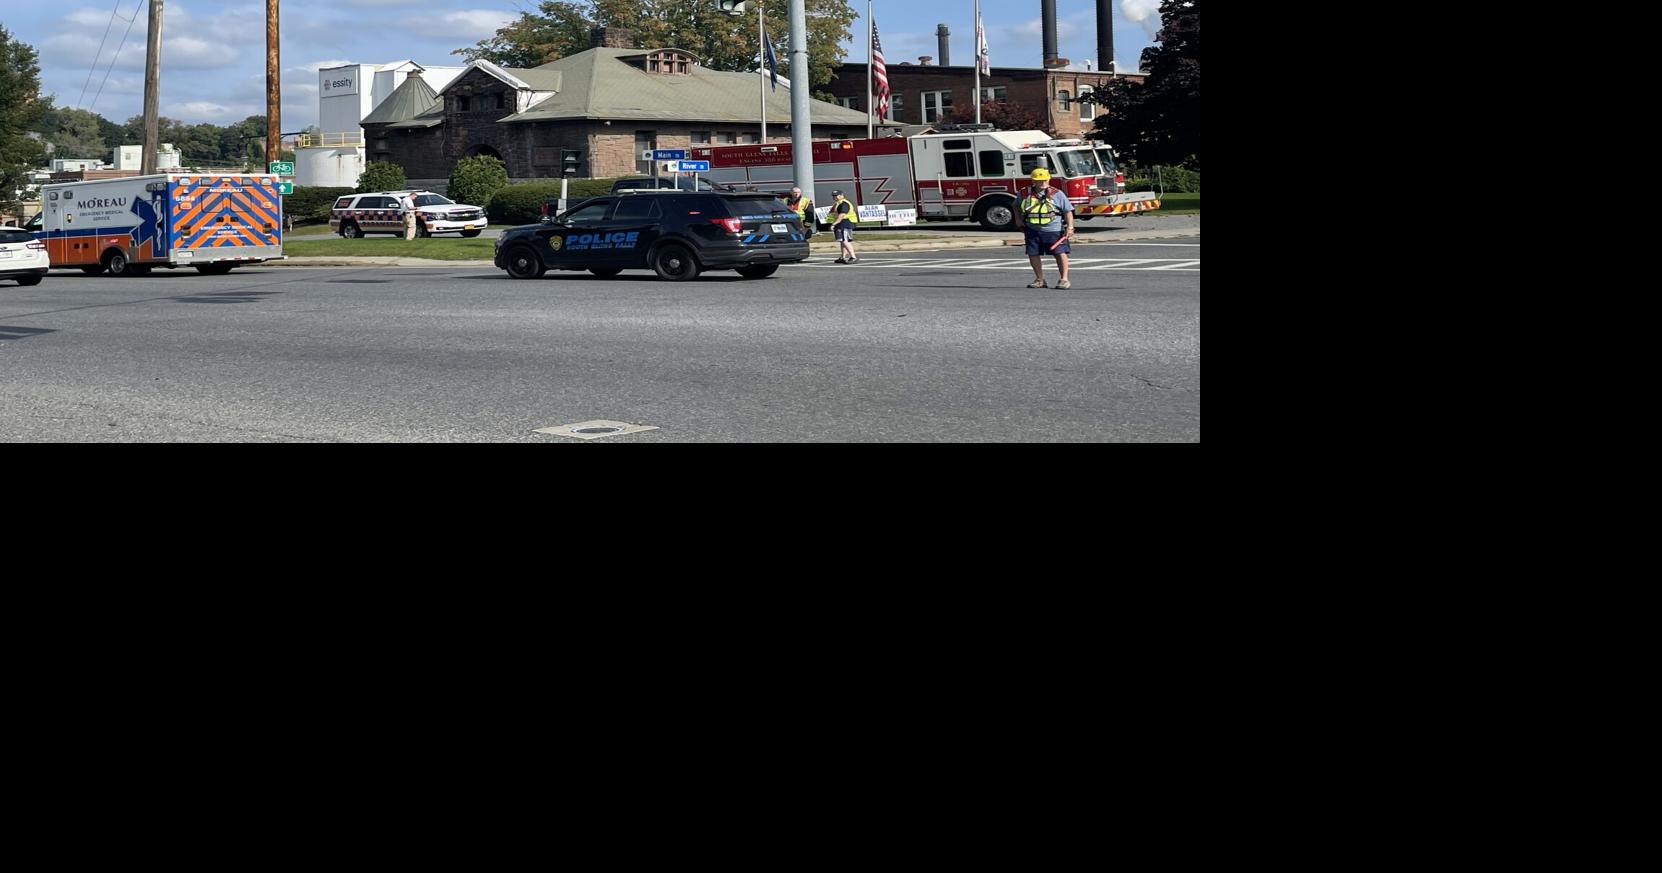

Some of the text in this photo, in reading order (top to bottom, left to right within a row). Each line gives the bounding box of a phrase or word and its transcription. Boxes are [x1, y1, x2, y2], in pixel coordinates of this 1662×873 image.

[332, 77, 353, 88] essity
[77, 197, 127, 209] MOREAU
[566, 232, 639, 245] POLICE
